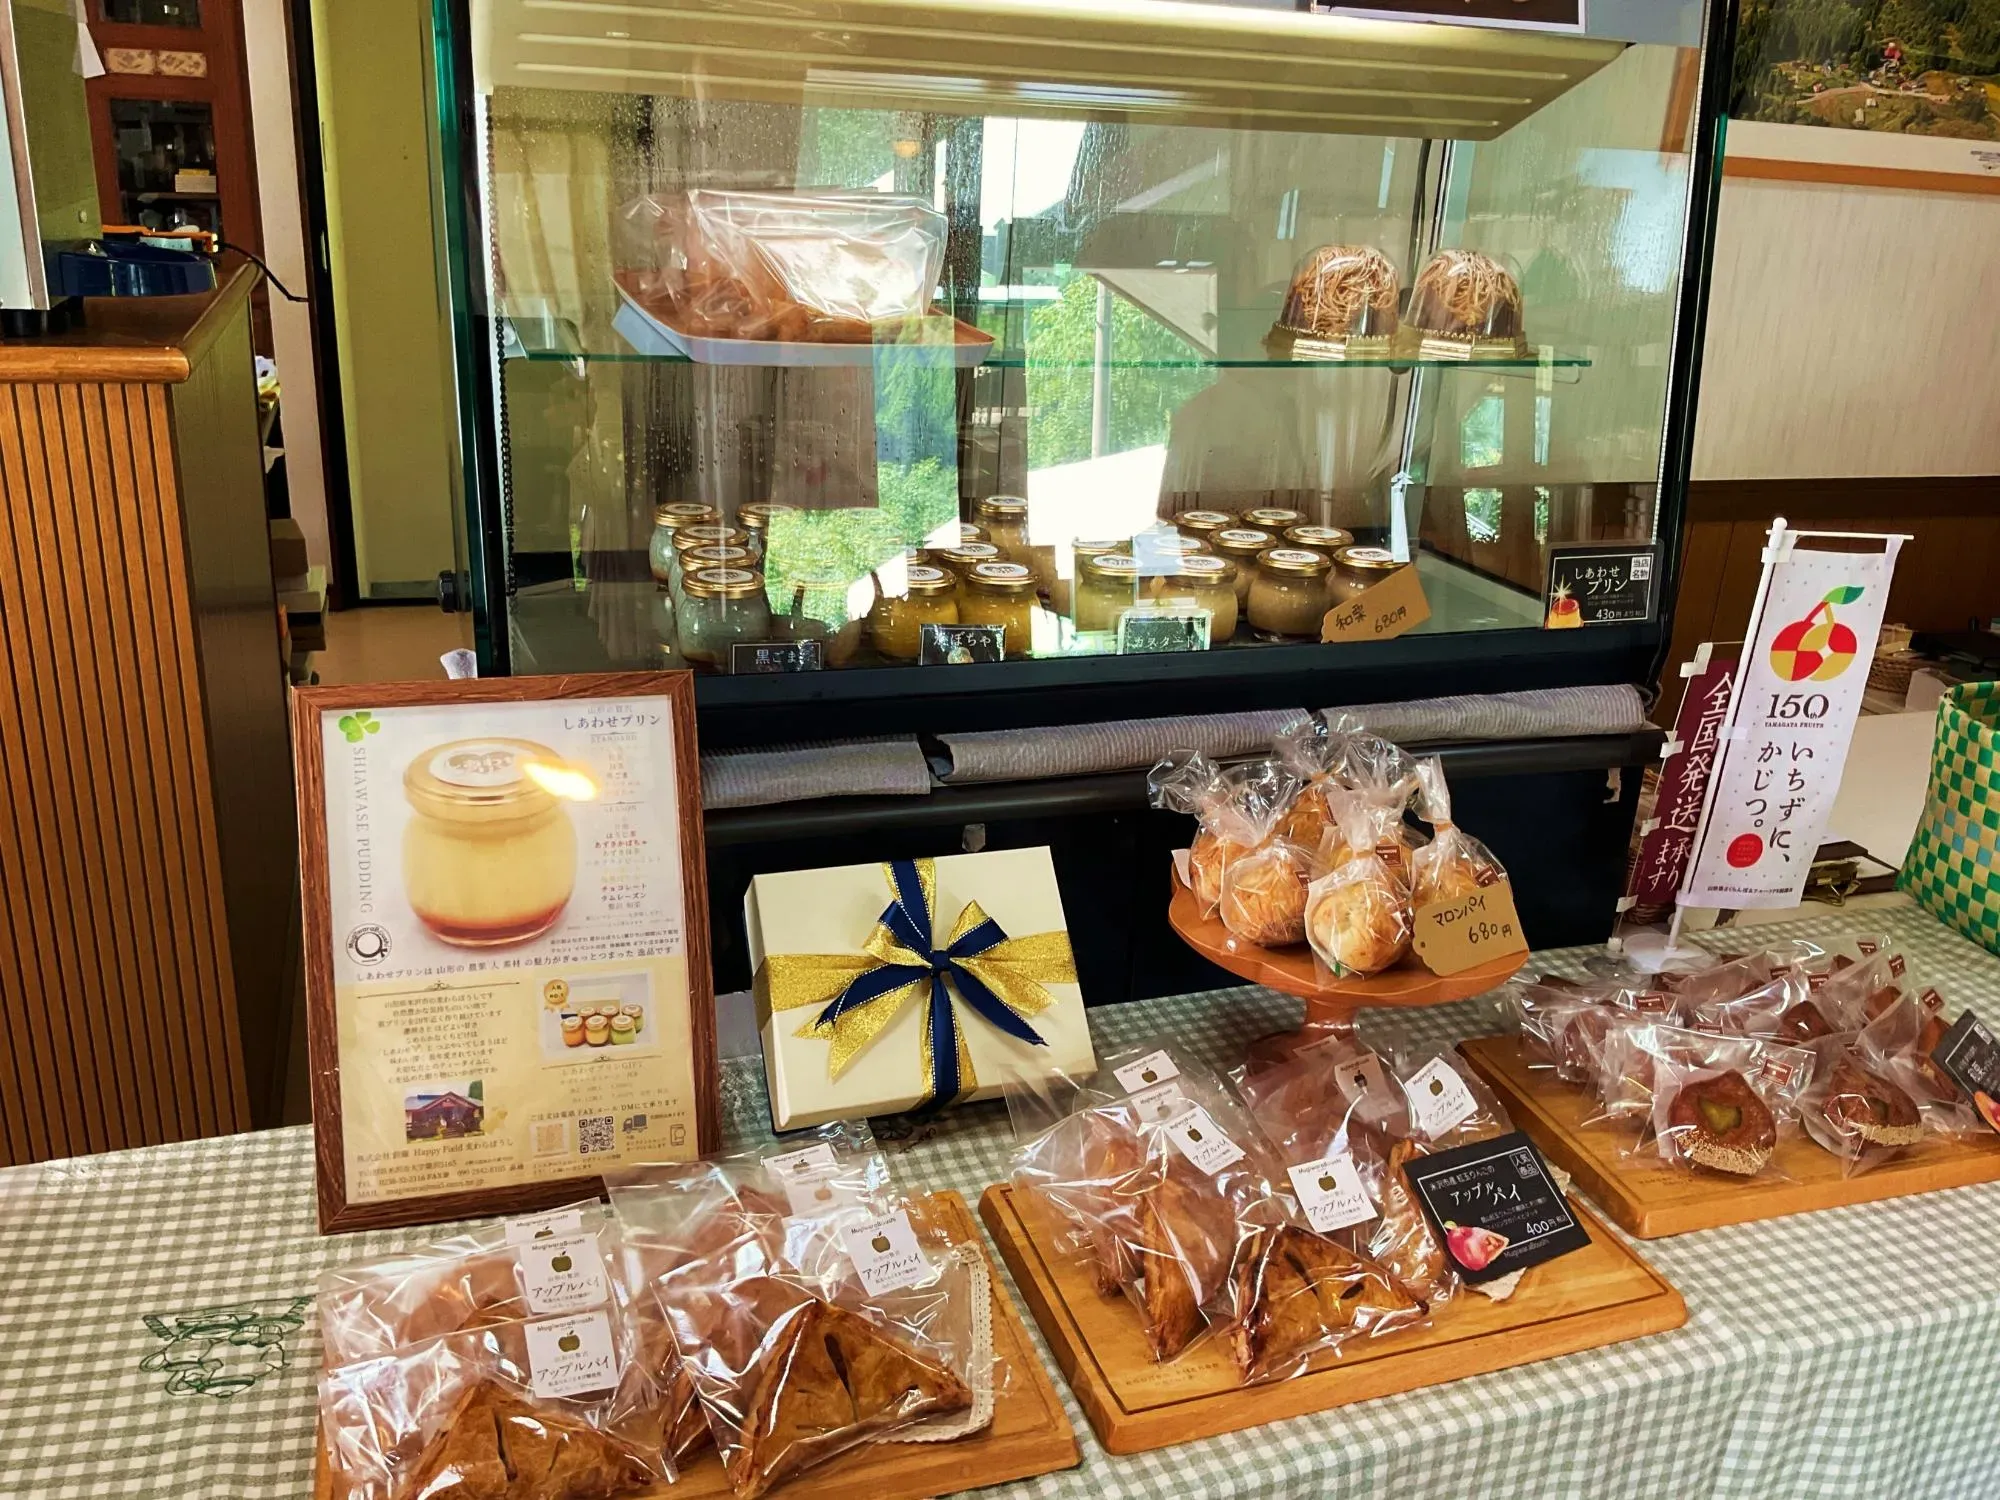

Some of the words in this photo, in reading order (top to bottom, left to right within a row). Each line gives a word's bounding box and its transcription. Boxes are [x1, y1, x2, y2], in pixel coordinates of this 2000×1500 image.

[1575, 565, 1620, 580] しあわせ
[1587, 577, 1628, 595] プリン
[1766, 692, 1830, 720] 150
[564, 714, 661, 730] しあわせプリン
[1664, 671, 1733, 832] 全国発送
[353, 747, 369, 833] SHIAWASE
[1746, 741, 1782, 828] かじつ。
[1769, 741, 1814, 864] いちずに、
[357, 838, 373, 914] PUDDING
[1432, 895, 1486, 927] マロンパイ
[1468, 922, 1512, 944] 680円
[357, 968, 432, 982] しあわせプリンは
[1308, 1193, 1365, 1217] アップルパイ
[1450, 1181, 1494, 1207] アップル
[862, 1252, 921, 1281] アップルパイ
[532, 1276, 601, 1298] アップルパイ
[537, 1355, 609, 1384] アップルパイ
